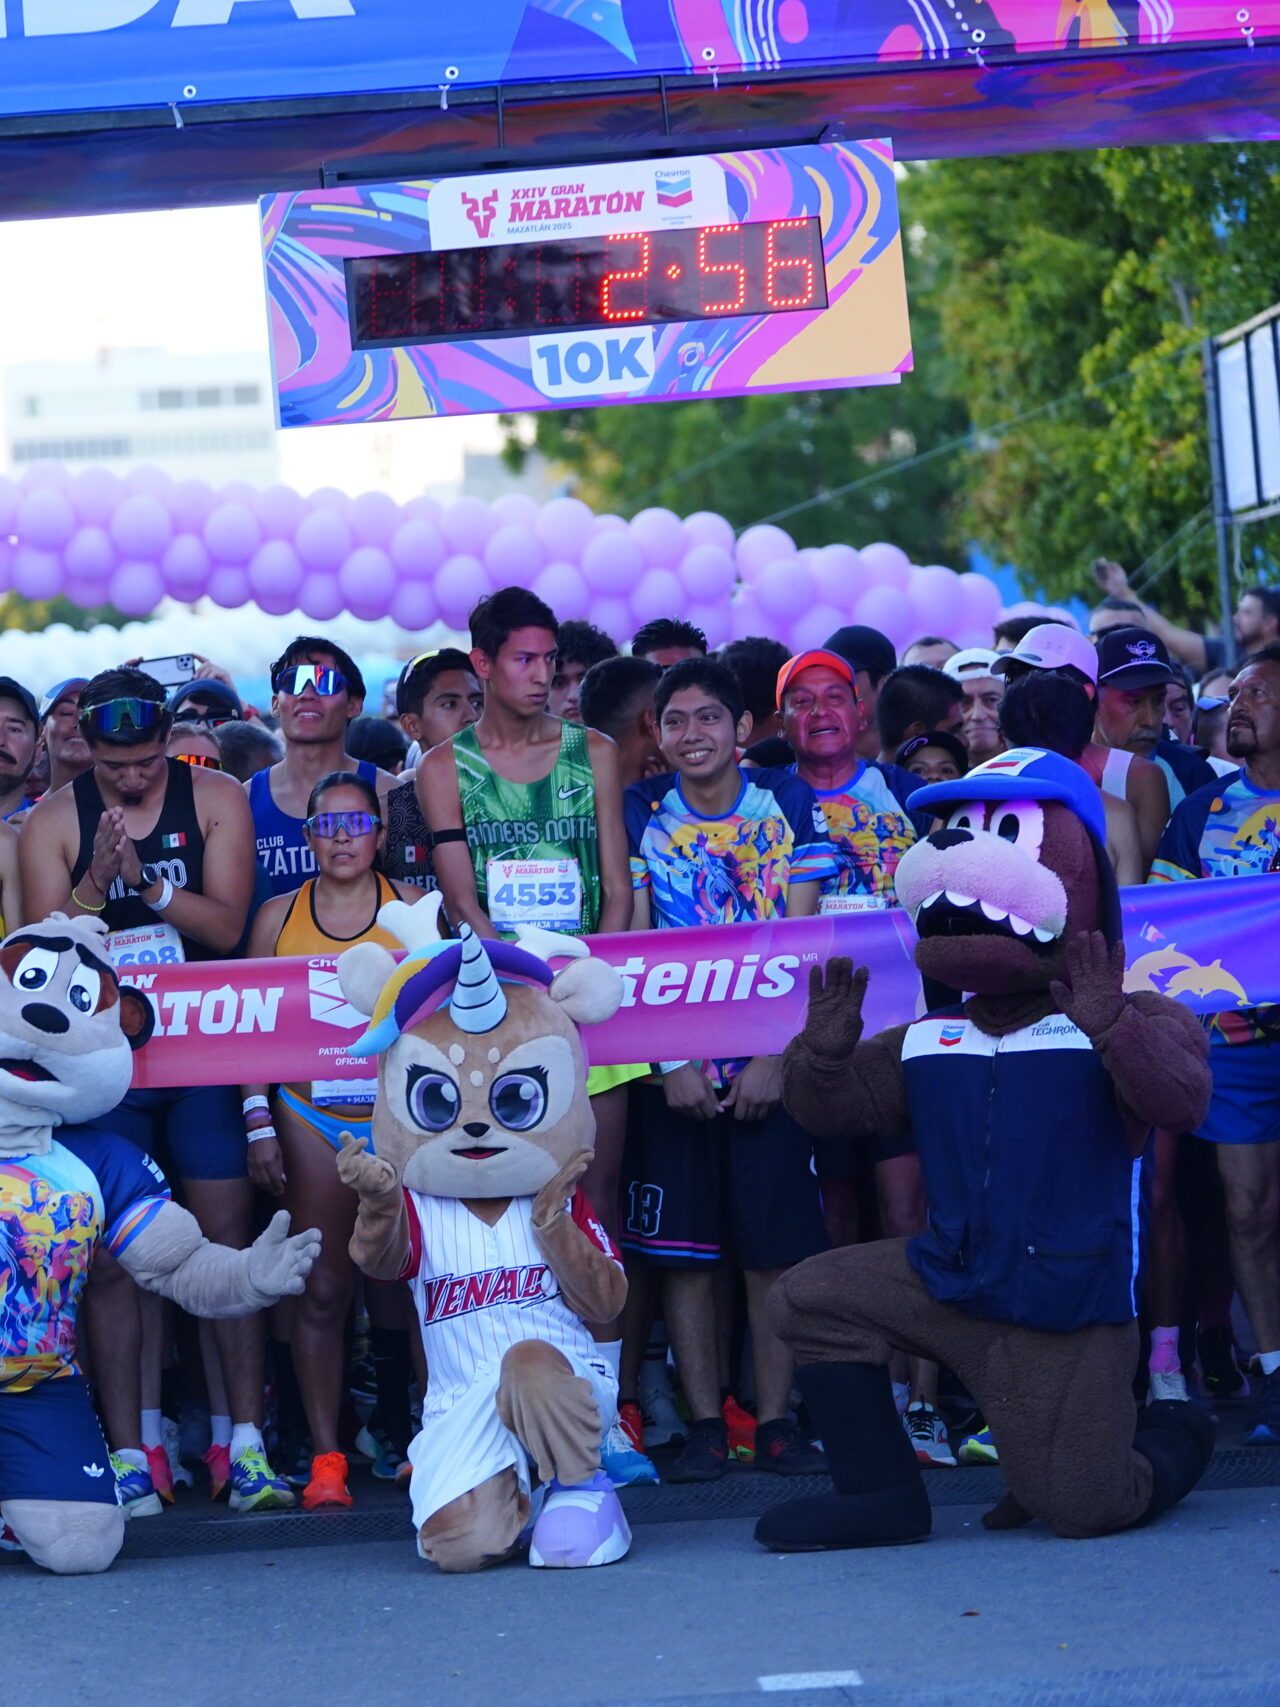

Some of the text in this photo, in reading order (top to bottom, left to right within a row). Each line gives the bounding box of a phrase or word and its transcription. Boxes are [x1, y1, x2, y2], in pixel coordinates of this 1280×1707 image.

[655, 170, 691, 178] Chevron
[511, 183, 586, 200] XXIV GRAN
[508, 190, 645, 222] MARATÓN
[507, 222, 572, 235] MAZATLÁN 2025
[536, 335, 650, 387] 10K
[256, 835, 284, 850] CLUB
[258, 846, 321, 877] ZATO
[494, 882, 576, 907] 4553
[111, 946, 181, 968] 698
[802, 953, 819, 963] MR
[119, 973, 158, 989] AN
[147, 983, 285, 1037] ATÓN
[1031, 1024, 1078, 1037] TECHRON
[318, 1046, 346, 1056] PATRO
[335, 1057, 369, 1067] OFICIAL
[627, 1181, 663, 1237] 13
